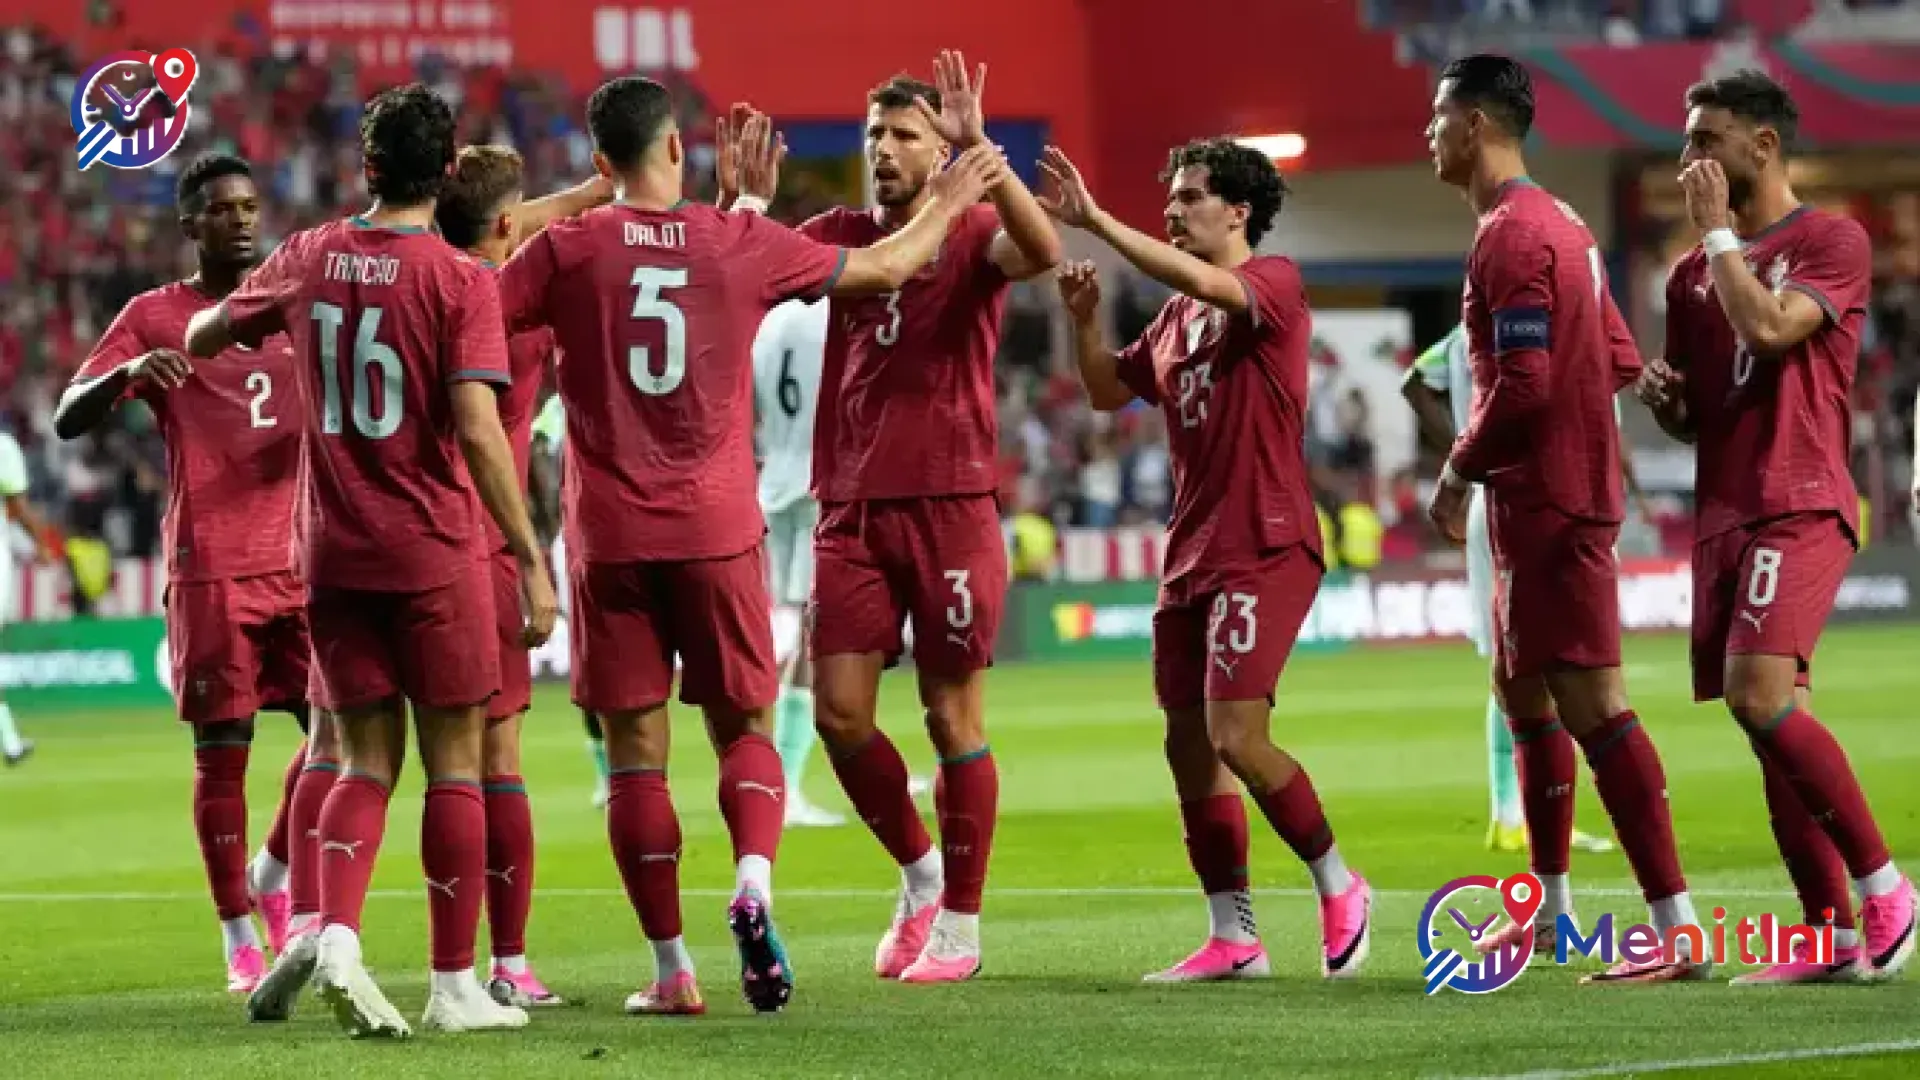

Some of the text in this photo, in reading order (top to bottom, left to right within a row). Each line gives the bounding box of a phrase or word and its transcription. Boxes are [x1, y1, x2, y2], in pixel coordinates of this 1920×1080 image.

[623, 221, 686, 247] DALOT
[628, 266, 689, 396] 5
[875, 289, 902, 346] 3
[246, 371, 278, 428] 2
[312, 302, 403, 438] 16
[777, 347, 802, 419] 6
[1178, 361, 1214, 428] 23
[943, 569, 973, 628] 3
[1748, 547, 1782, 605] 8
[1207, 592, 1258, 653] 23
